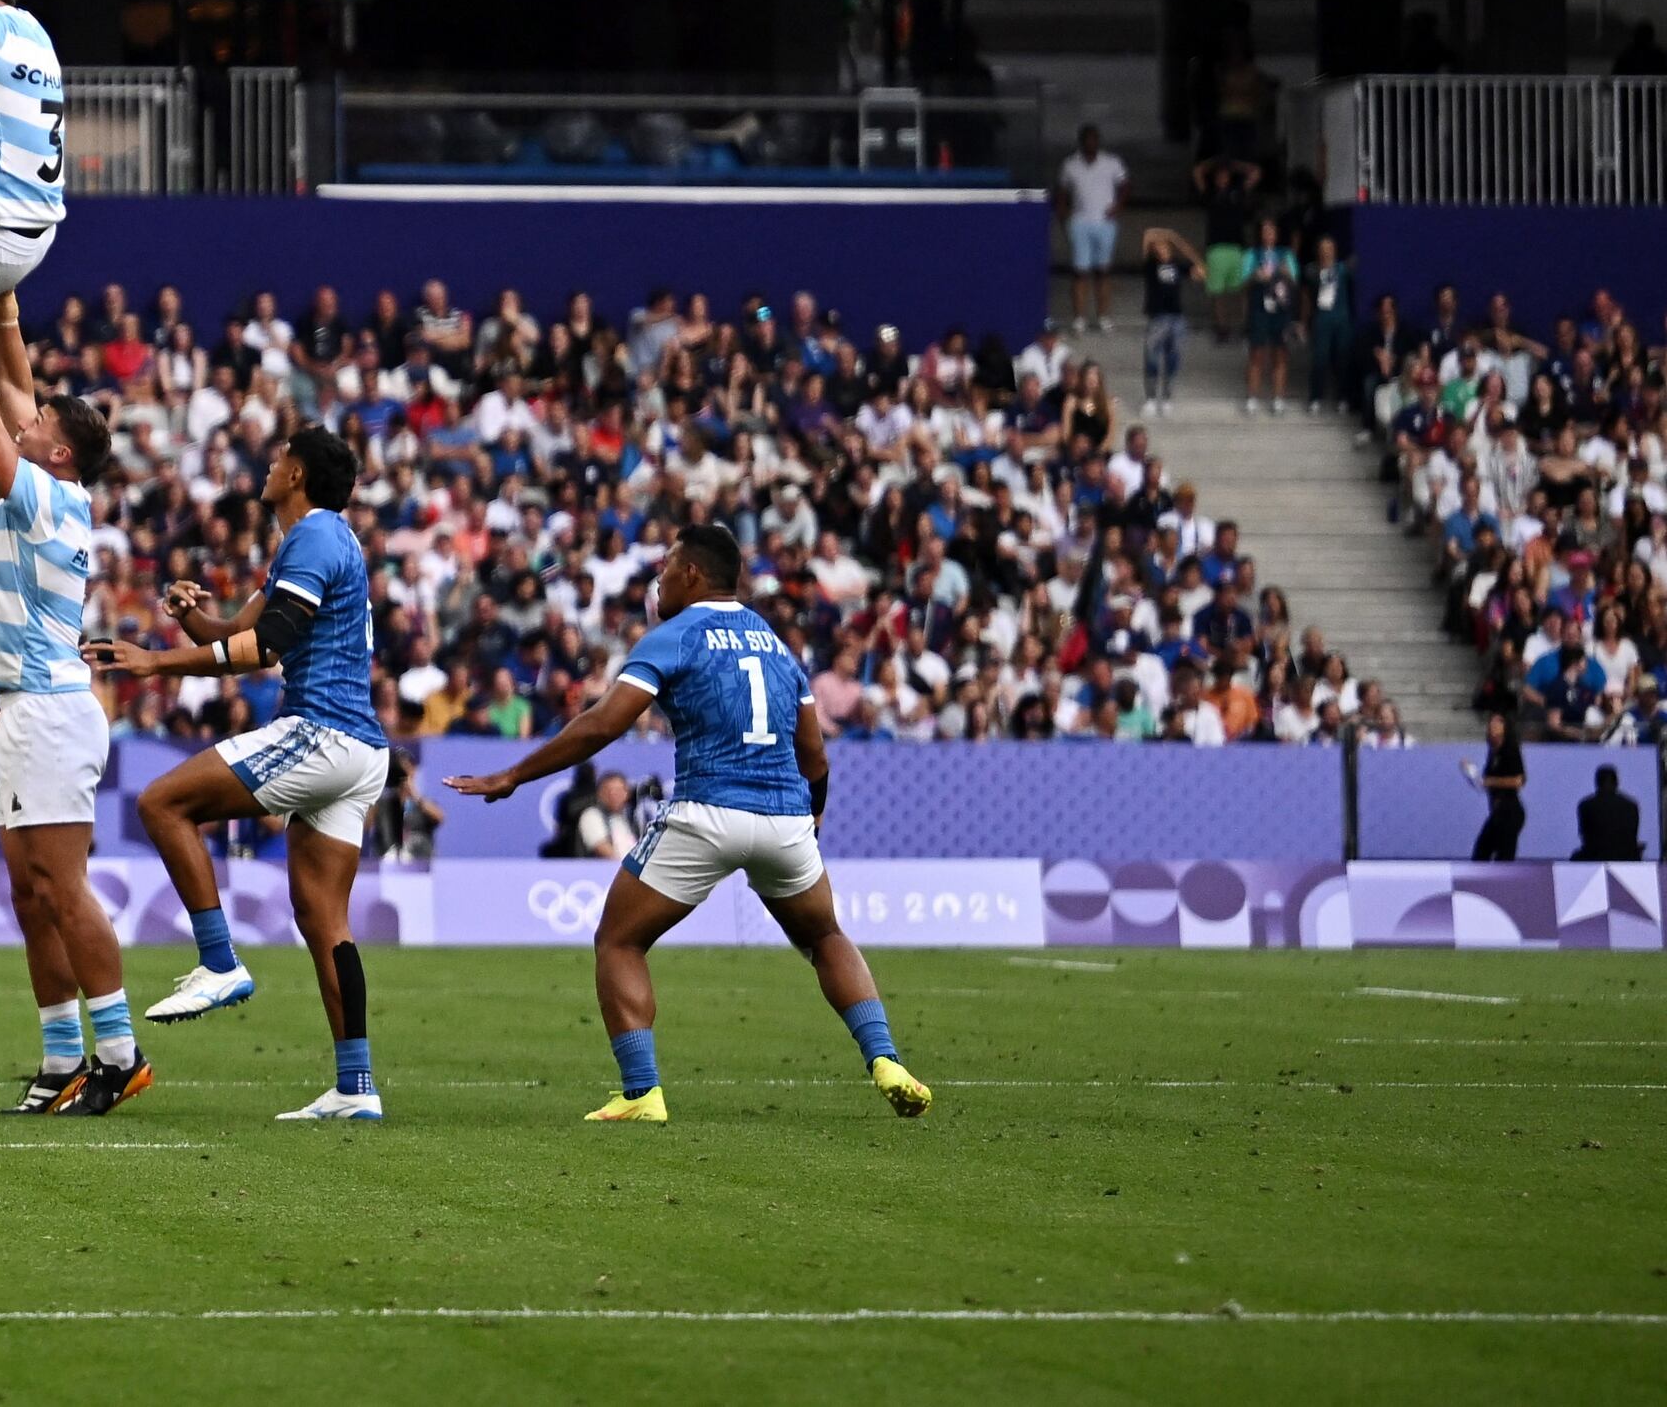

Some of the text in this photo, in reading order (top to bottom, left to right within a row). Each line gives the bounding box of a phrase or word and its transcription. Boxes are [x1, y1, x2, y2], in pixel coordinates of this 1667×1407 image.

[36, 98, 64, 184] 3
[705, 629, 744, 651] AFA
[738, 655, 777, 746] 1
[904, 893, 1018, 923] 2024
